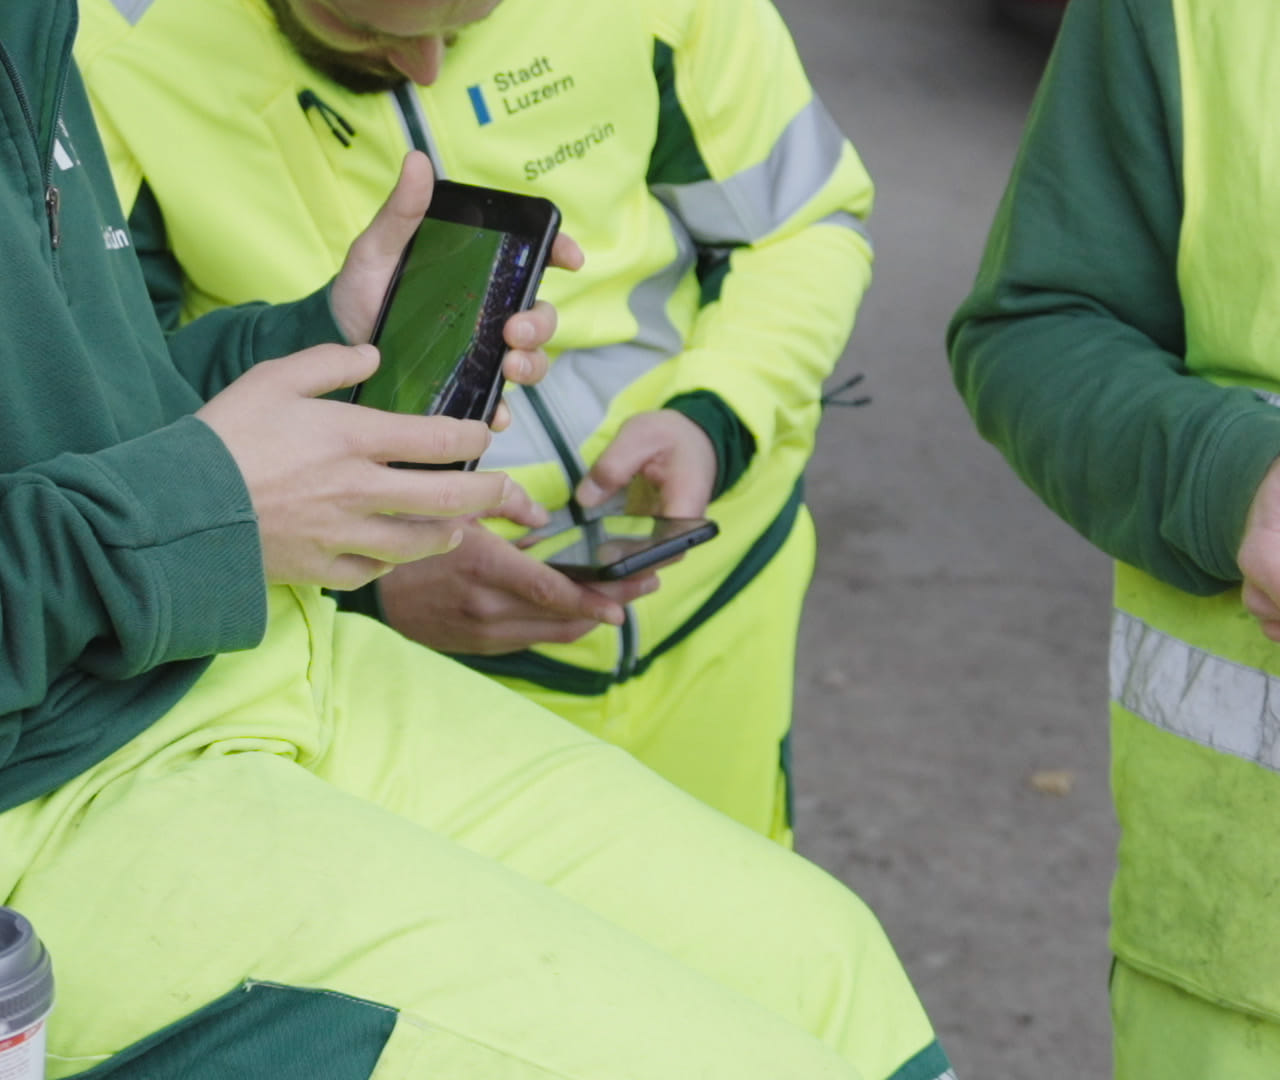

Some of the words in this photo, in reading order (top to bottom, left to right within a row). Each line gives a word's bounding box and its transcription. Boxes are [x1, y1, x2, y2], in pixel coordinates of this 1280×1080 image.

[493, 56, 554, 92] Stadt
[502, 75, 575, 116] Luzern
[523, 122, 616, 181] Stadtgrün
